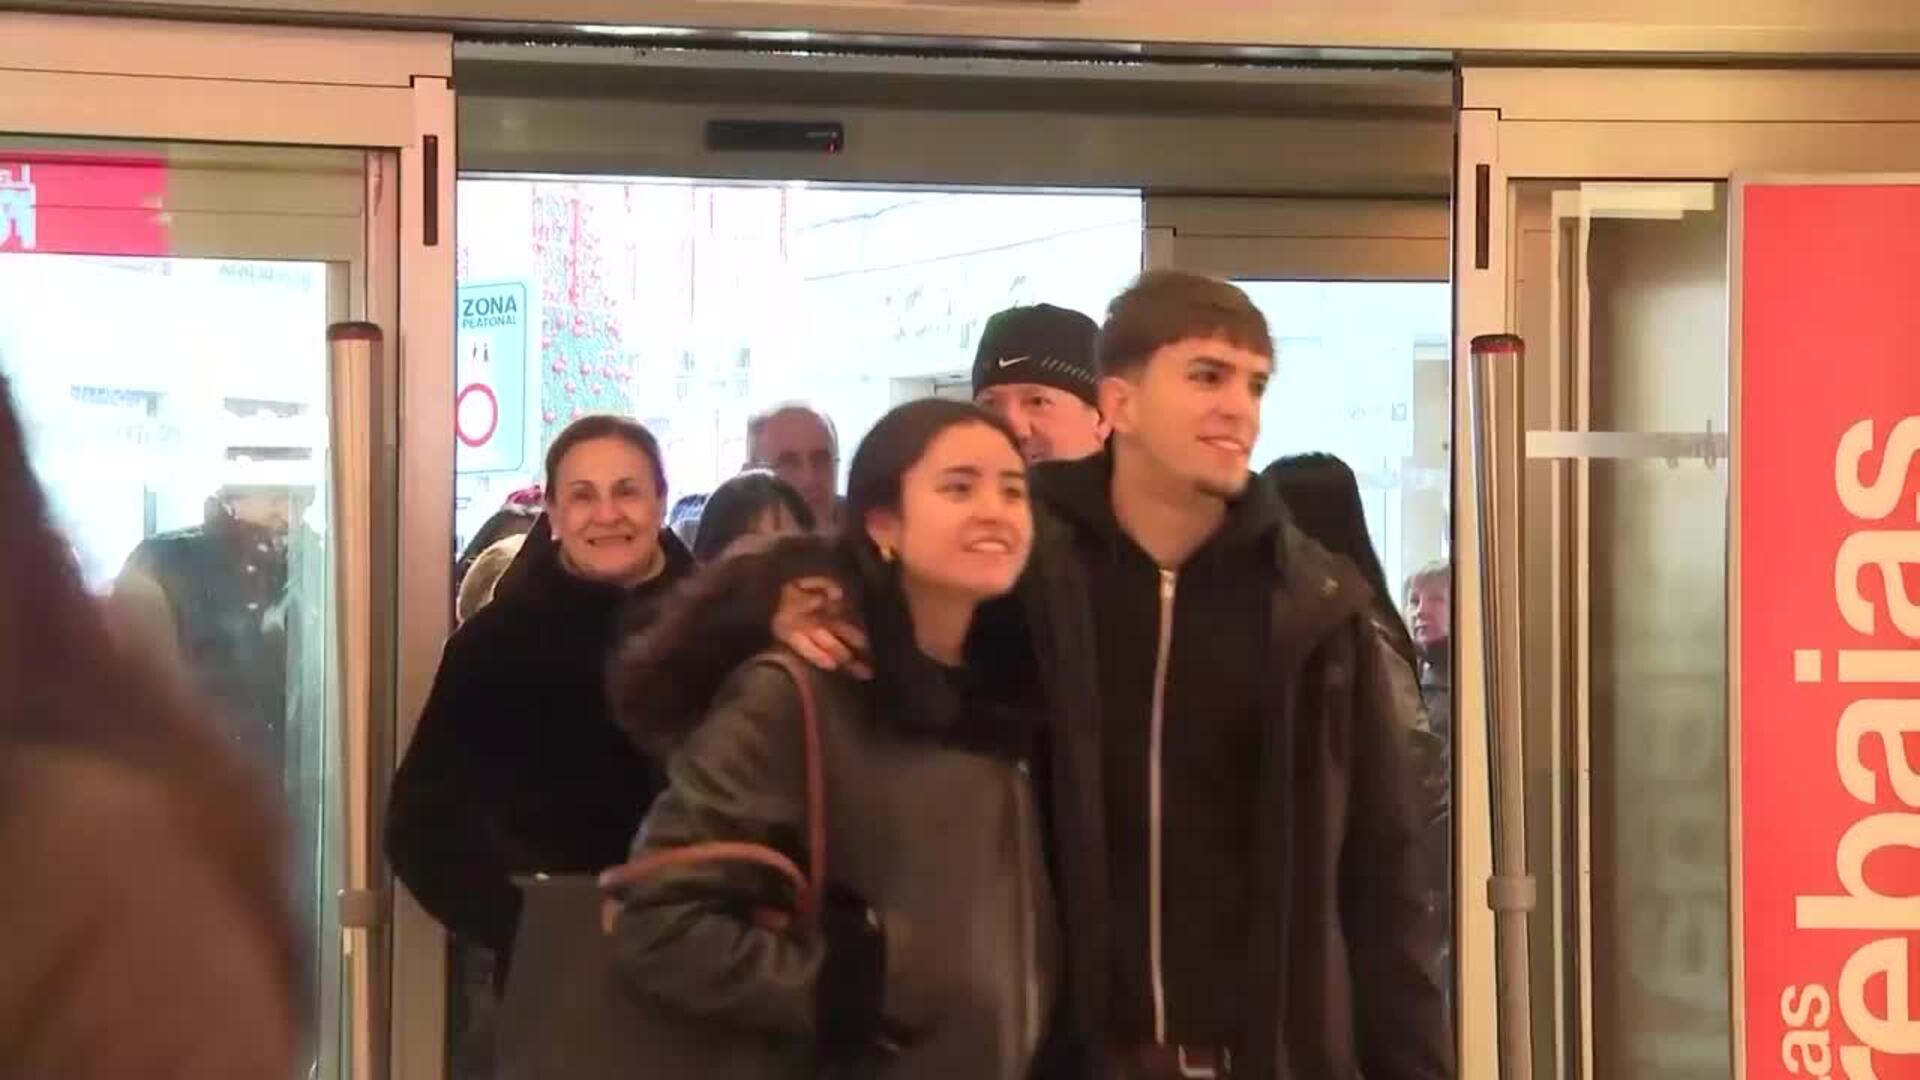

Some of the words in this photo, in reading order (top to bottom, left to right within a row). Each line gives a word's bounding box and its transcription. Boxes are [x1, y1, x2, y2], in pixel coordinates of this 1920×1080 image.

[463, 295, 517, 317] ZONA
[463, 315, 517, 329] PEATONAL
[1780, 983, 1832, 1080] as
